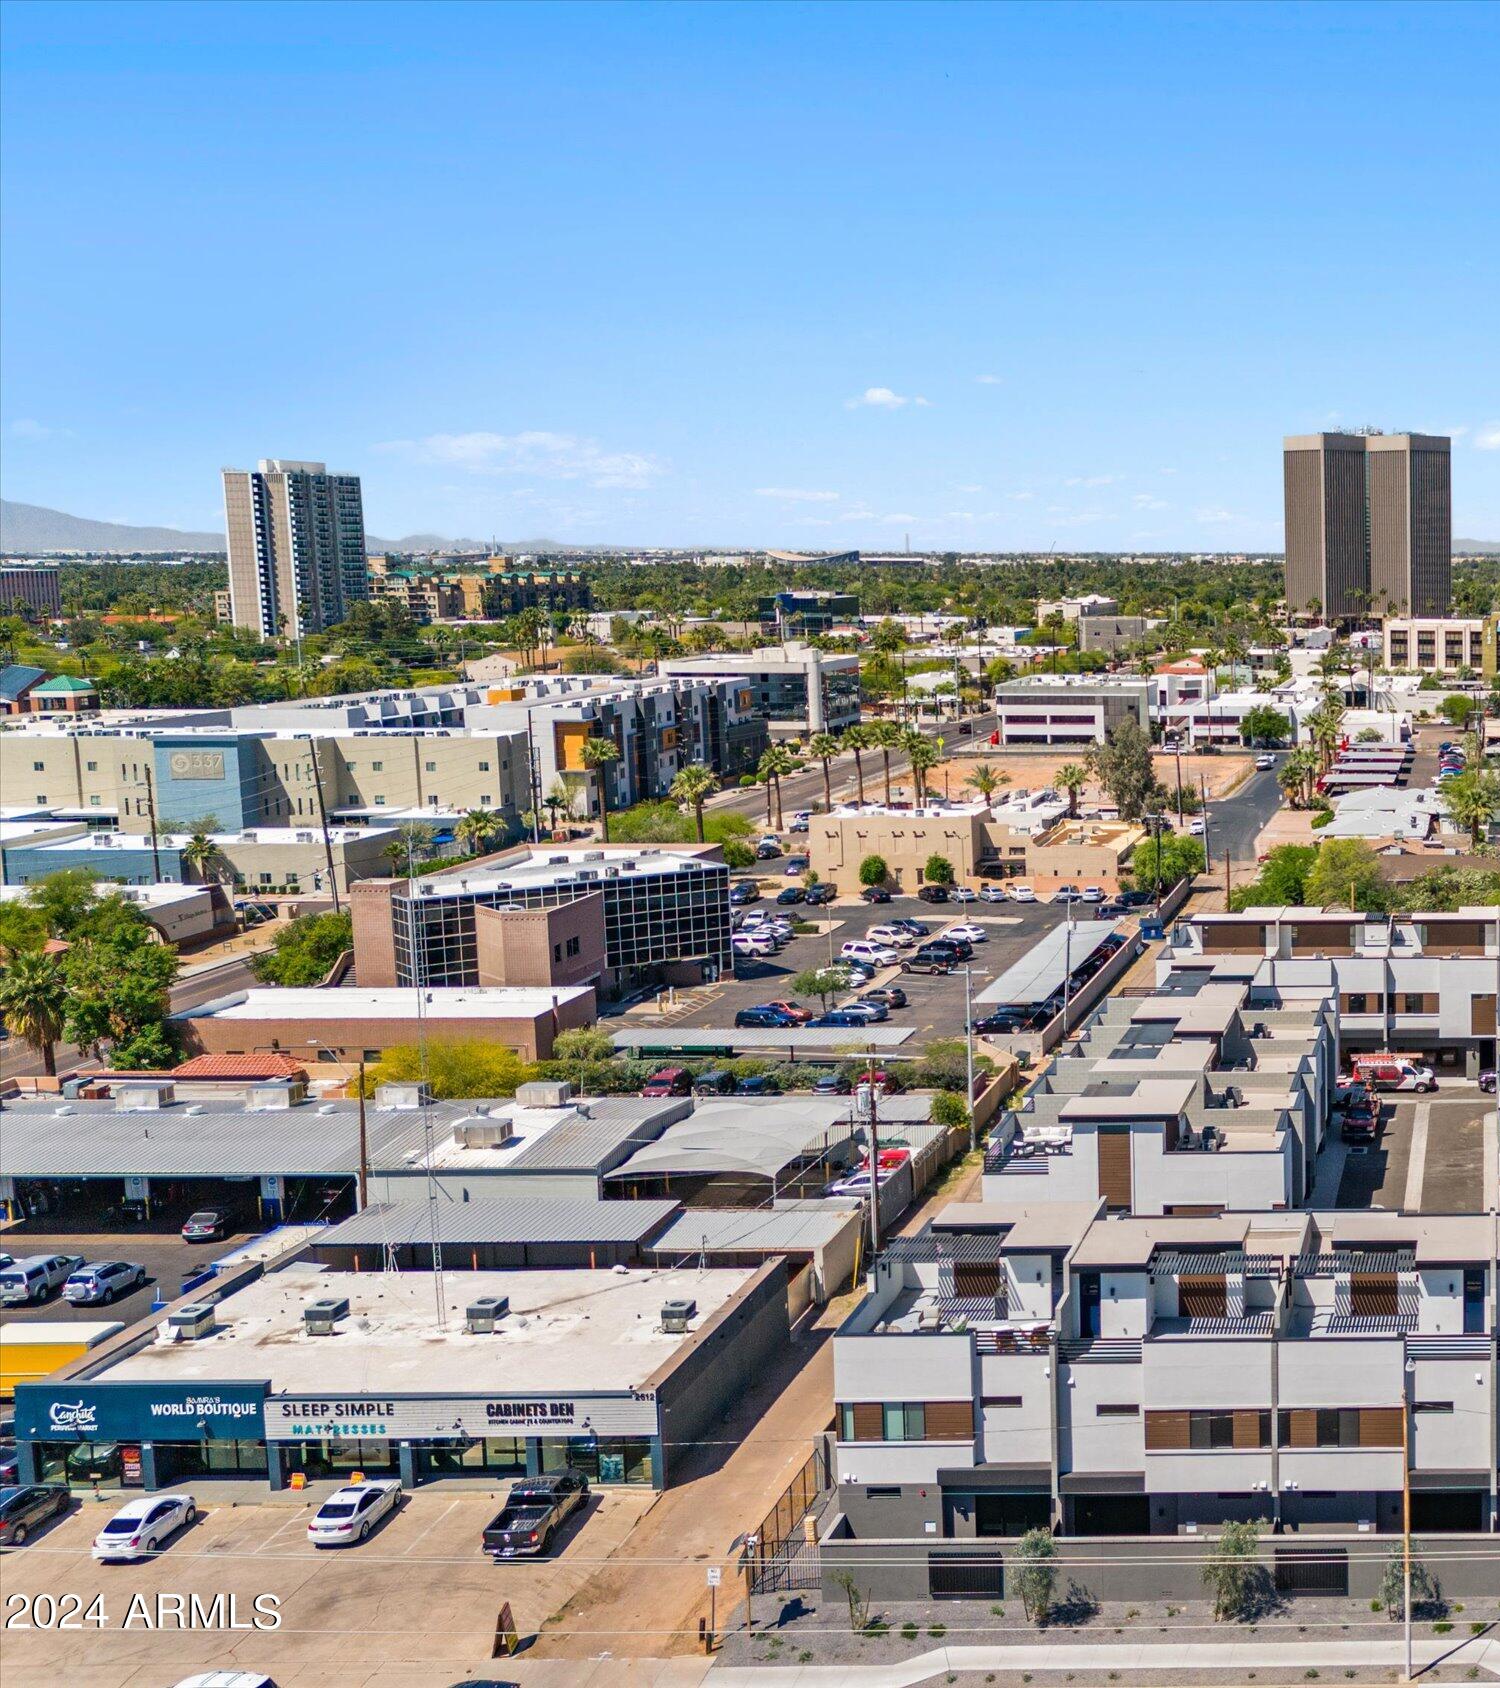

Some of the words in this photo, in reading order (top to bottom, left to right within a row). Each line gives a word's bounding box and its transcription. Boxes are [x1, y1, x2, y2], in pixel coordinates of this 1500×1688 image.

[150, 1403, 195, 1416] WORLD
[196, 1403, 257, 1417] BOUTIQUE
[282, 1403, 330, 1417] SLEEP
[335, 1403, 395, 1417] SIMPLE
[486, 1402, 548, 1417] CABINETS
[550, 1402, 574, 1417] DEN
